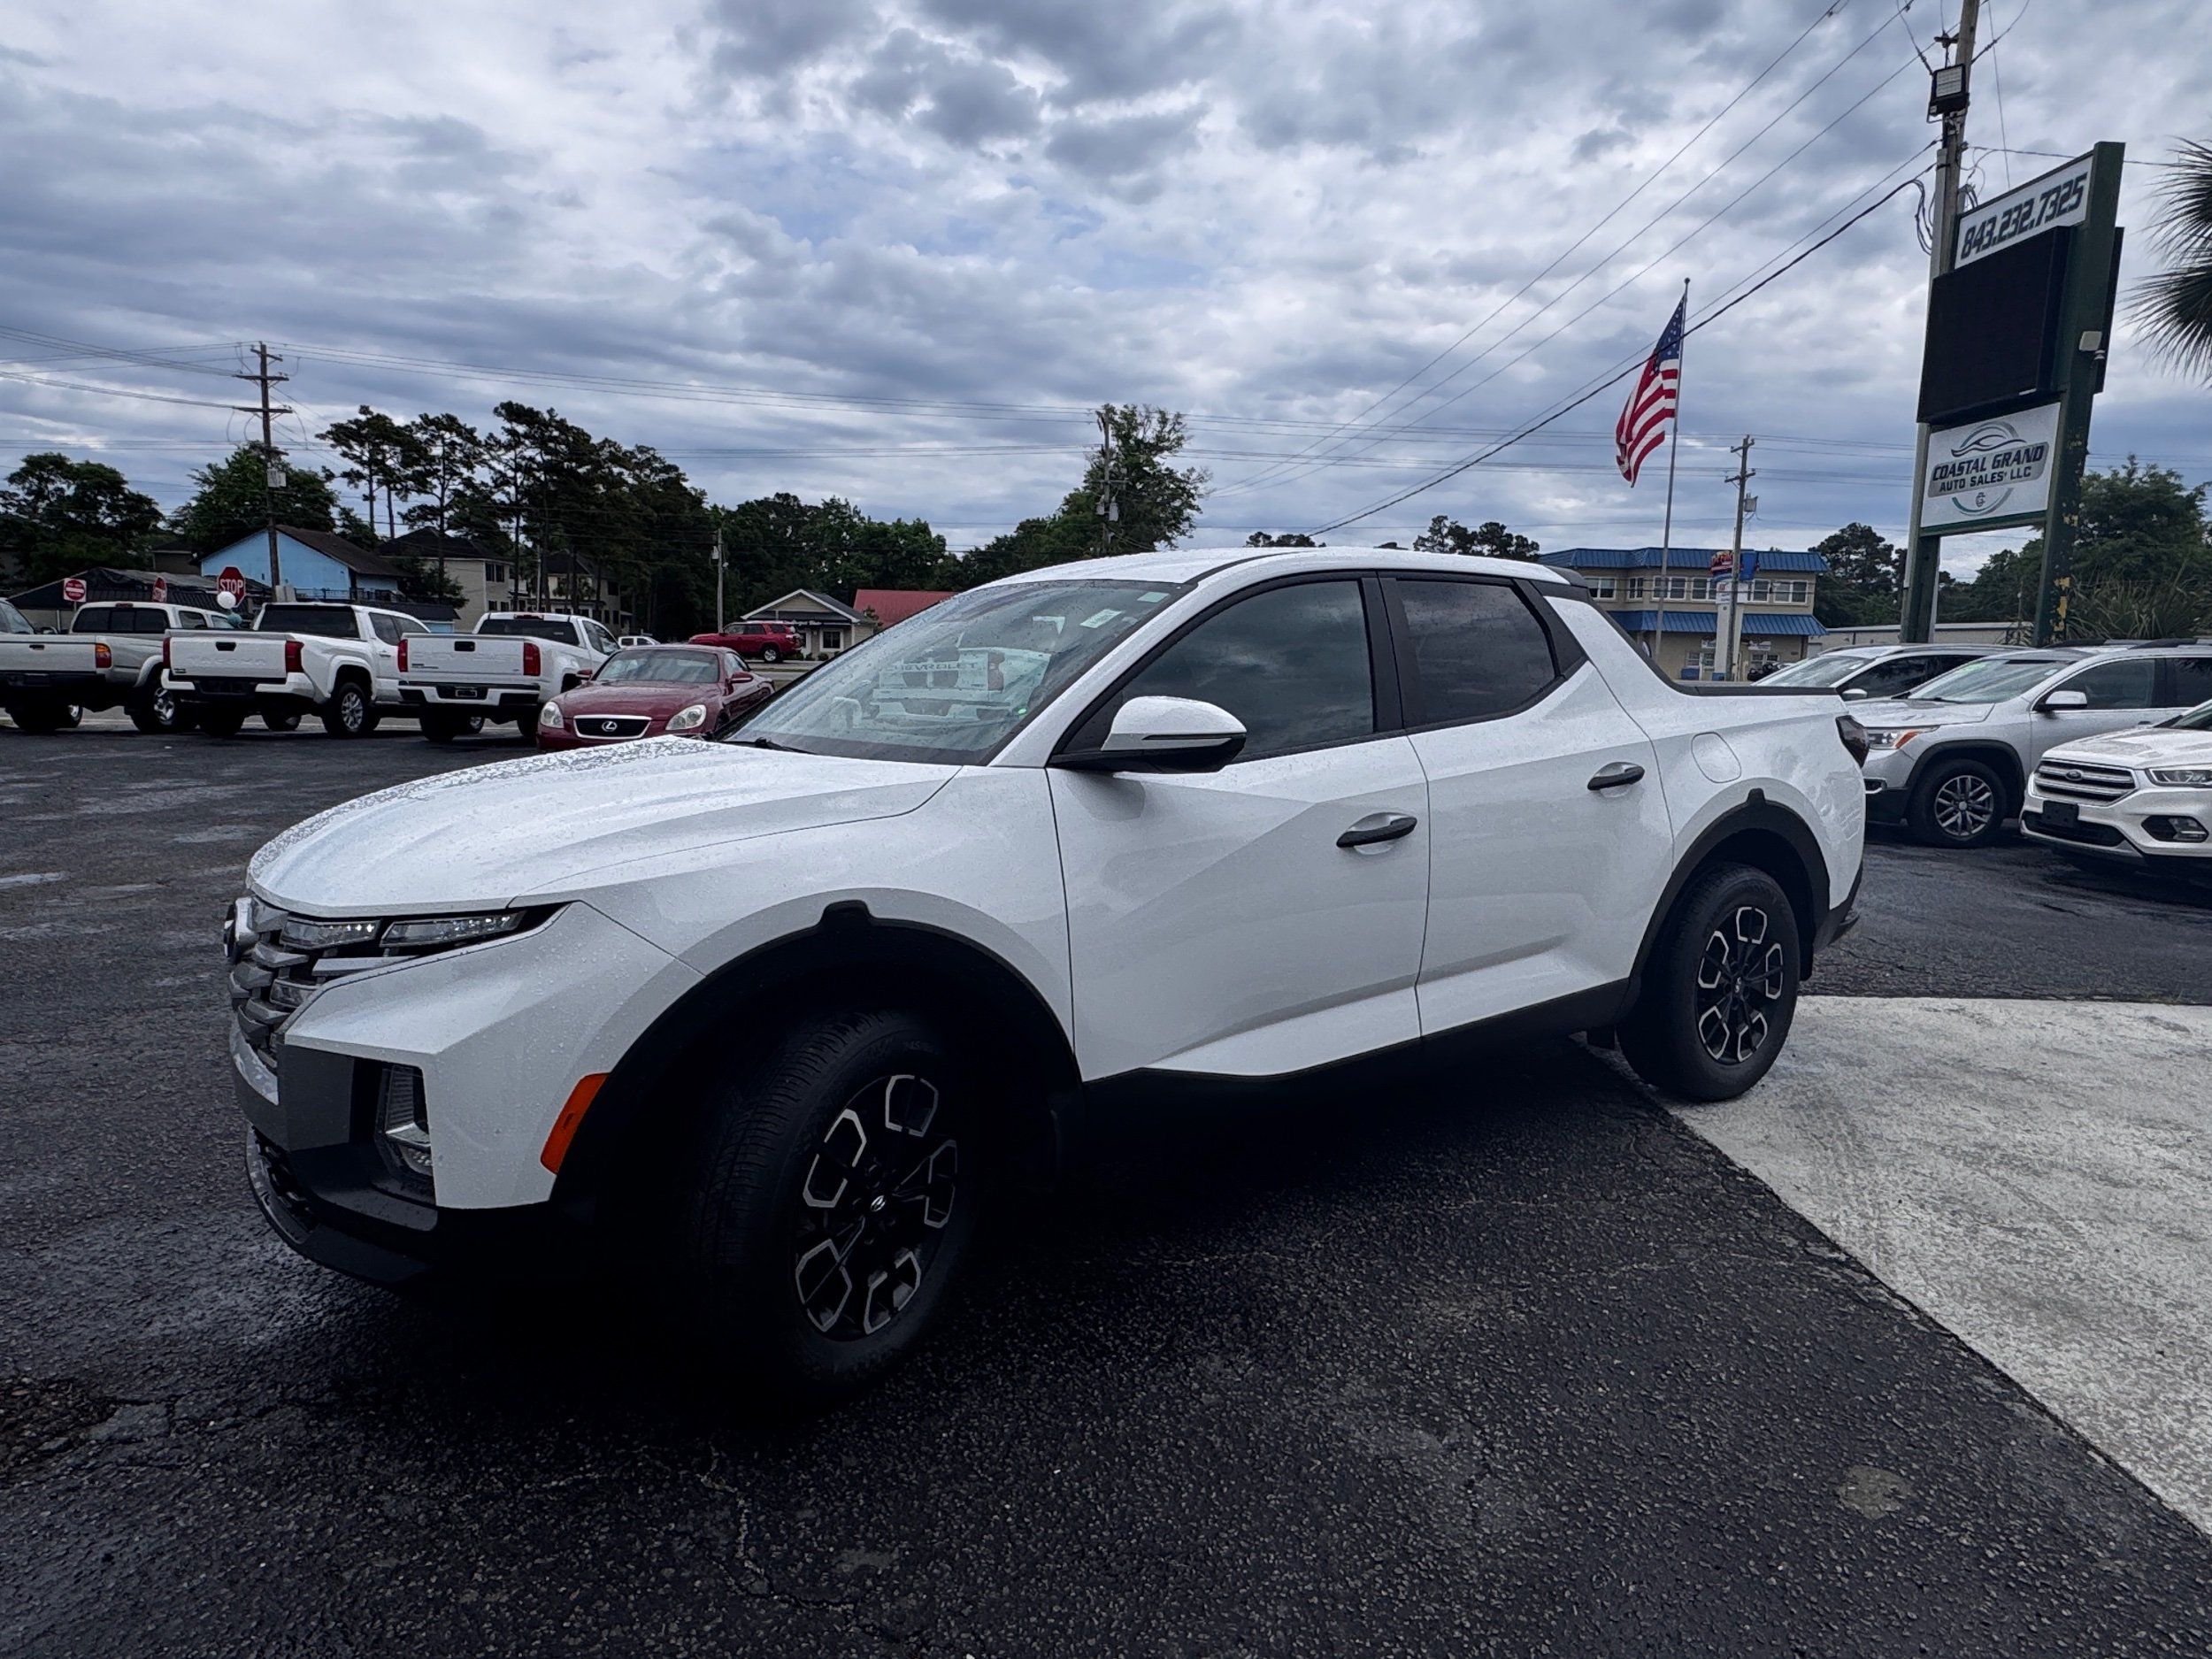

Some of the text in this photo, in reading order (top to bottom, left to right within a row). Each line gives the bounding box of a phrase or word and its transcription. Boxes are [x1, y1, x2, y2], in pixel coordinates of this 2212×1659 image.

[1961, 172, 2088, 259] 843.232.7325
[1932, 445, 2045, 481] COASTAL GRAND
[1939, 478, 1966, 492] AUTO
[2010, 465, 2032, 480] LLC
[219, 578, 244, 595] STOP
